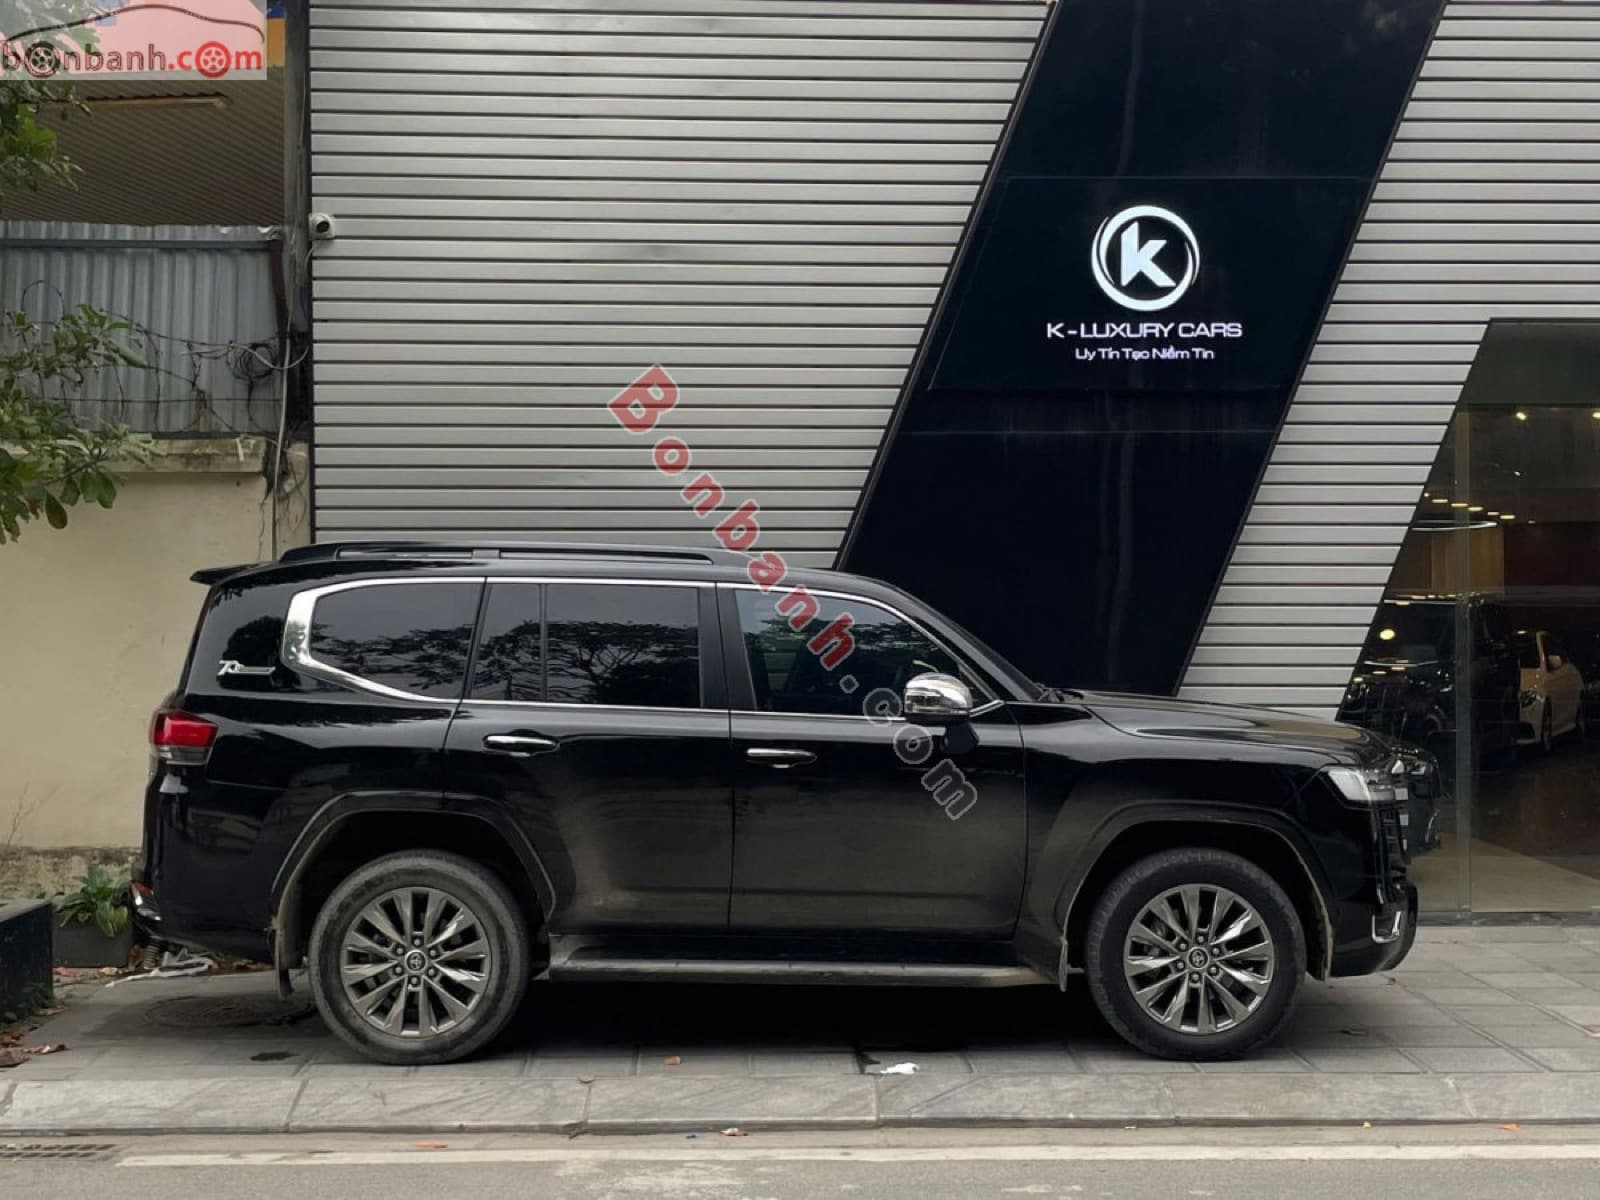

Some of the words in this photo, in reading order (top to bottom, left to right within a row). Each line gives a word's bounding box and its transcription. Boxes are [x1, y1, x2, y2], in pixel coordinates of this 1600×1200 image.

[1177, 322, 1243, 338] CARS
[1075, 347, 1097, 361] Uy
[1191, 347, 1215, 360] Tin
